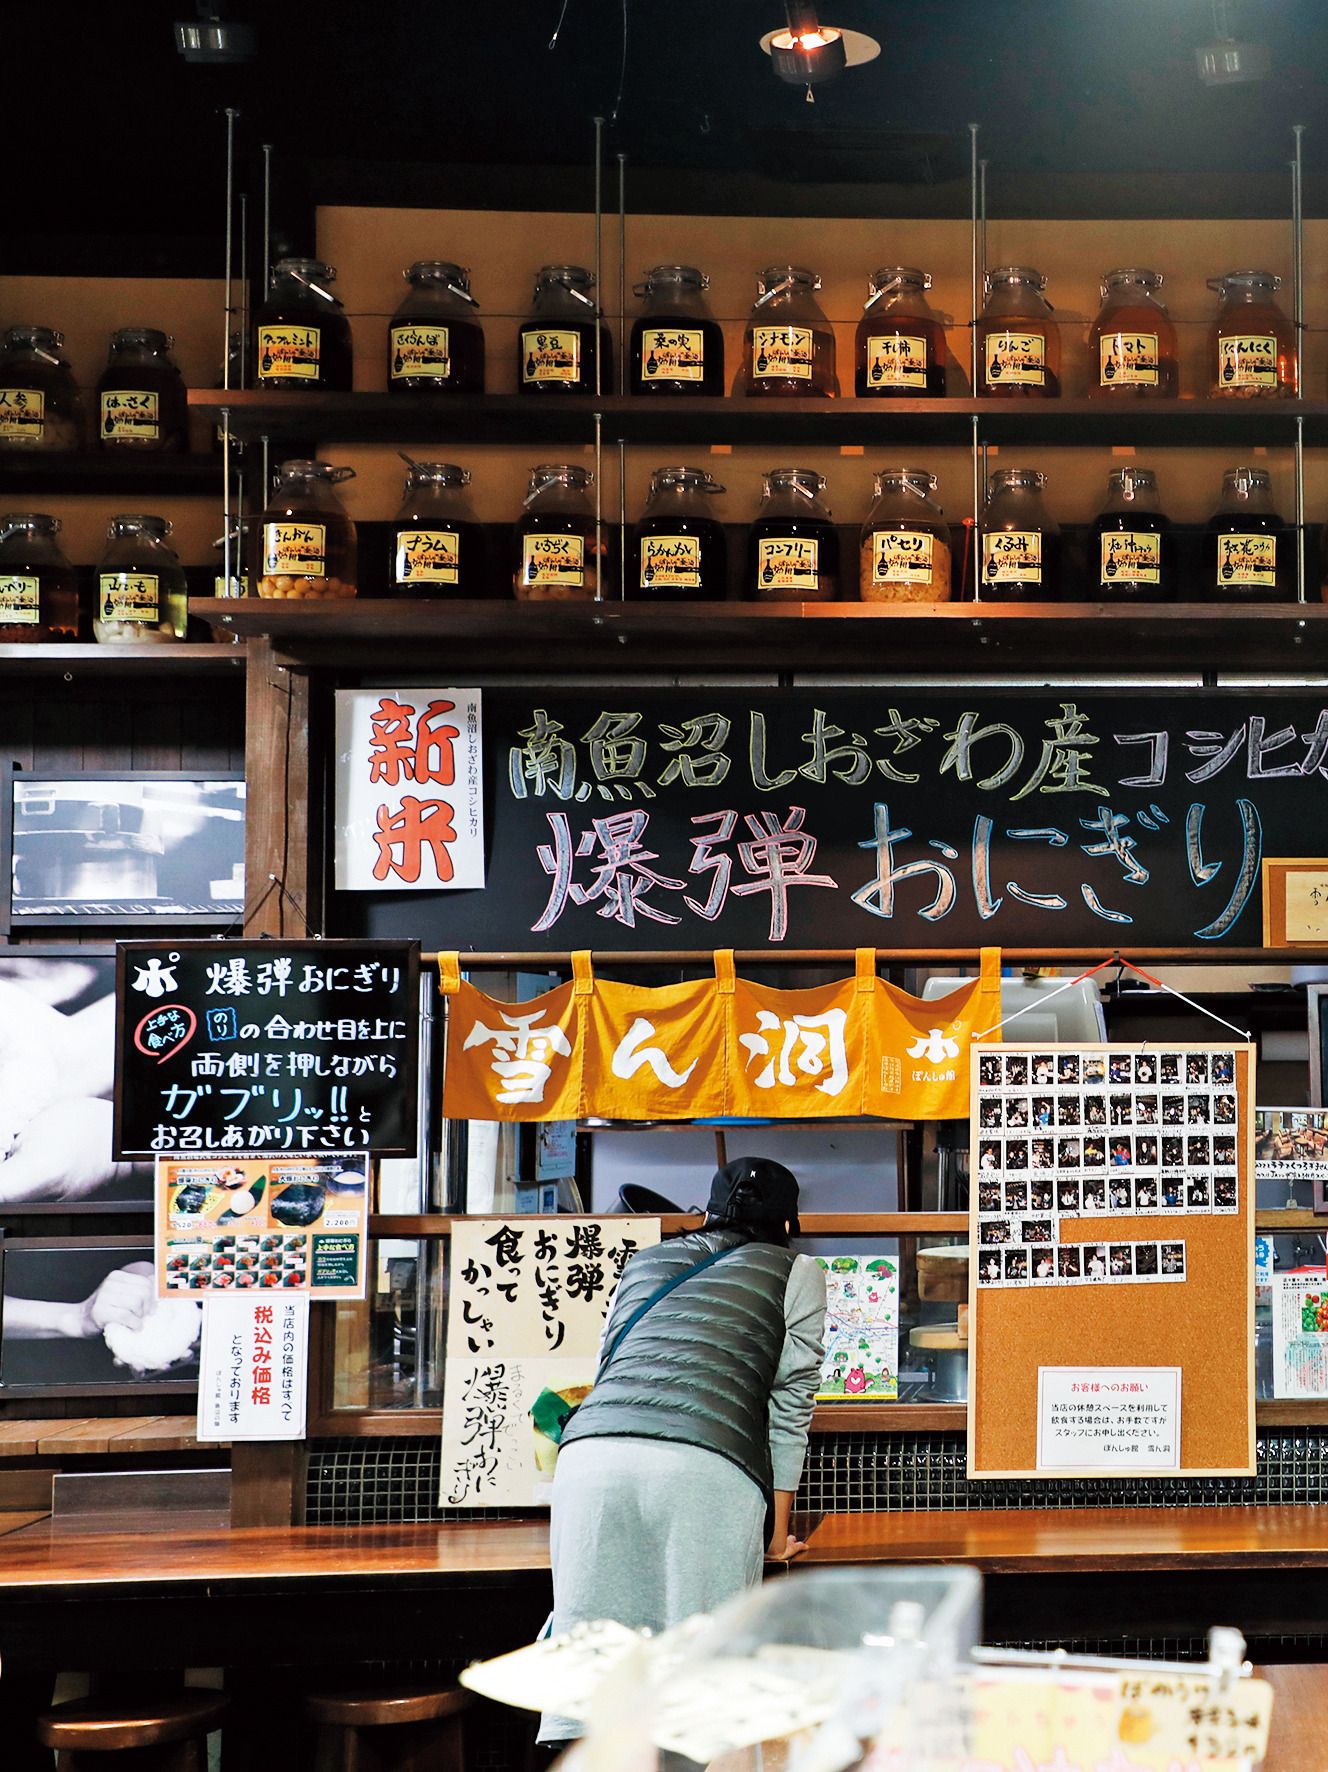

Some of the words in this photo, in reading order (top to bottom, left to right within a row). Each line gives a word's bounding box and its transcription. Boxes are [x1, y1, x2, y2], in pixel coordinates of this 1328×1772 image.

[397, 331, 440, 348] さくらんぼ
[536, 331, 564, 351] 黒豆
[758, 329, 807, 347] シナモン
[997, 336, 1035, 353] りんご
[1111, 336, 1146, 353] トマト
[763, 539, 813, 558] コンフリー
[881, 532, 923, 551] パセリ
[465, 702, 481, 838] 南魚沼しおざわ産コシヒカリ
[370, 698, 459, 883] 新米
[531, 799, 1263, 942] 爆弾おにぎり
[205, 957, 401, 998] 爆弾おにぎり
[239, 1013, 407, 1041] の合わせ目を上に
[191, 1051, 398, 1079] 両側を押しながら
[462, 1006, 850, 1105] 雪ん洞
[911, 1069, 956, 1082] ぽんしゅ館
[149, 1123, 371, 1150] お召しあがり下さい
[485, 1225, 524, 1303] 食って
[564, 1224, 606, 1303] 爆弾
[534, 1229, 566, 1351] おにぎり
[461, 1258, 495, 1353] かっしゃい
[251, 1305, 273, 1405] 税込み価格
[281, 1305, 295, 1421] 当店内の価格はすべて
[229, 1334, 242, 1423] となっております
[1071, 1382, 1149, 1393] お客様へのお願い
[1051, 1403, 1168, 1413] 当店の休憩スペースを利用して
